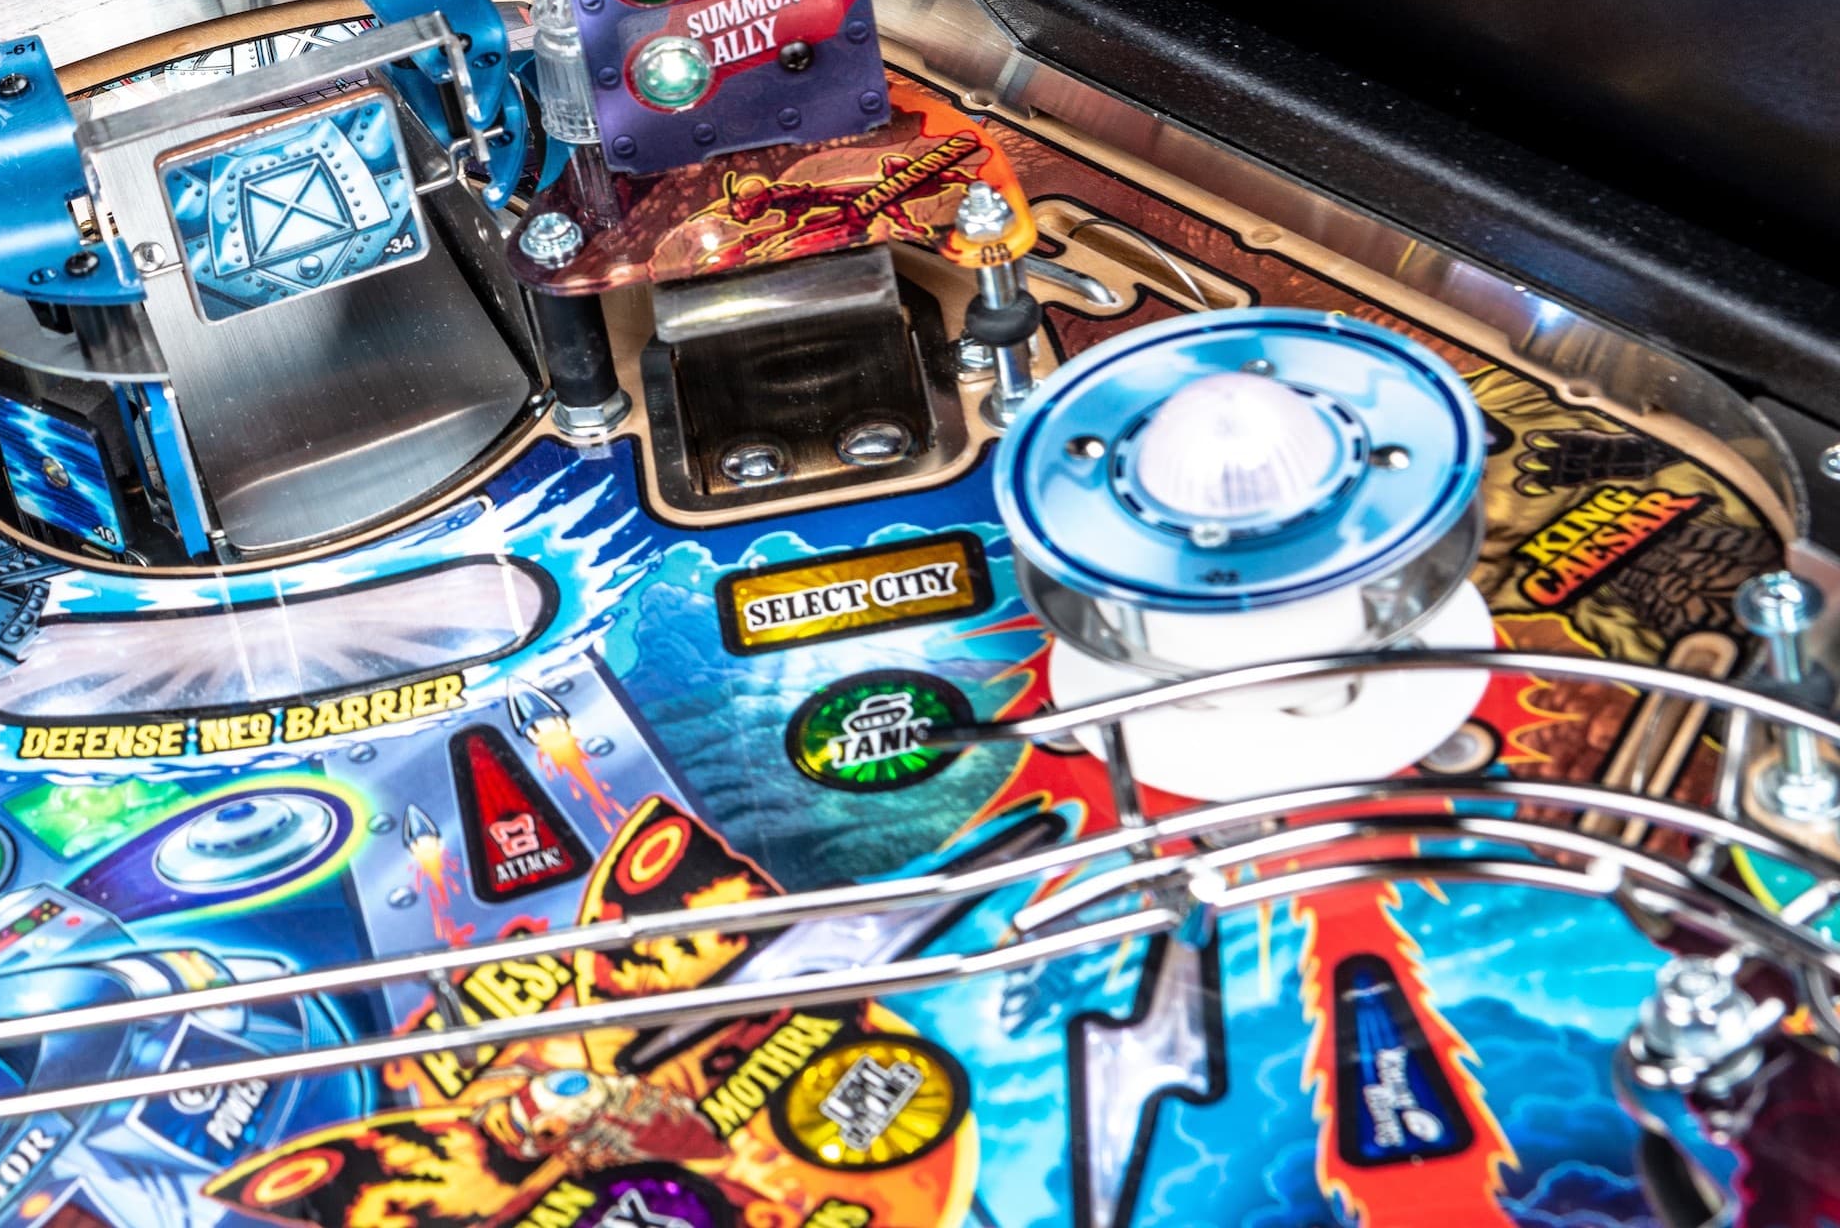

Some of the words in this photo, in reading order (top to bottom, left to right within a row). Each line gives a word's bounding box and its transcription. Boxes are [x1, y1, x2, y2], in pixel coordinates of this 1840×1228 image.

[6, 42, 36, 56] -61
[711, 16, 779, 68] ALLY
[854, 138, 978, 215] KAMACURAS
[384, 234, 414, 254] -34
[1518, 487, 1642, 565] KING
[1522, 491, 1702, 606] CAESAR
[749, 584, 864, 627] SELECT
[874, 566, 955, 602] CITY
[19, 722, 185, 759] DEFENSE
[283, 674, 464, 742] BARRIER
[702, 1013, 843, 1137] MOTHRA
